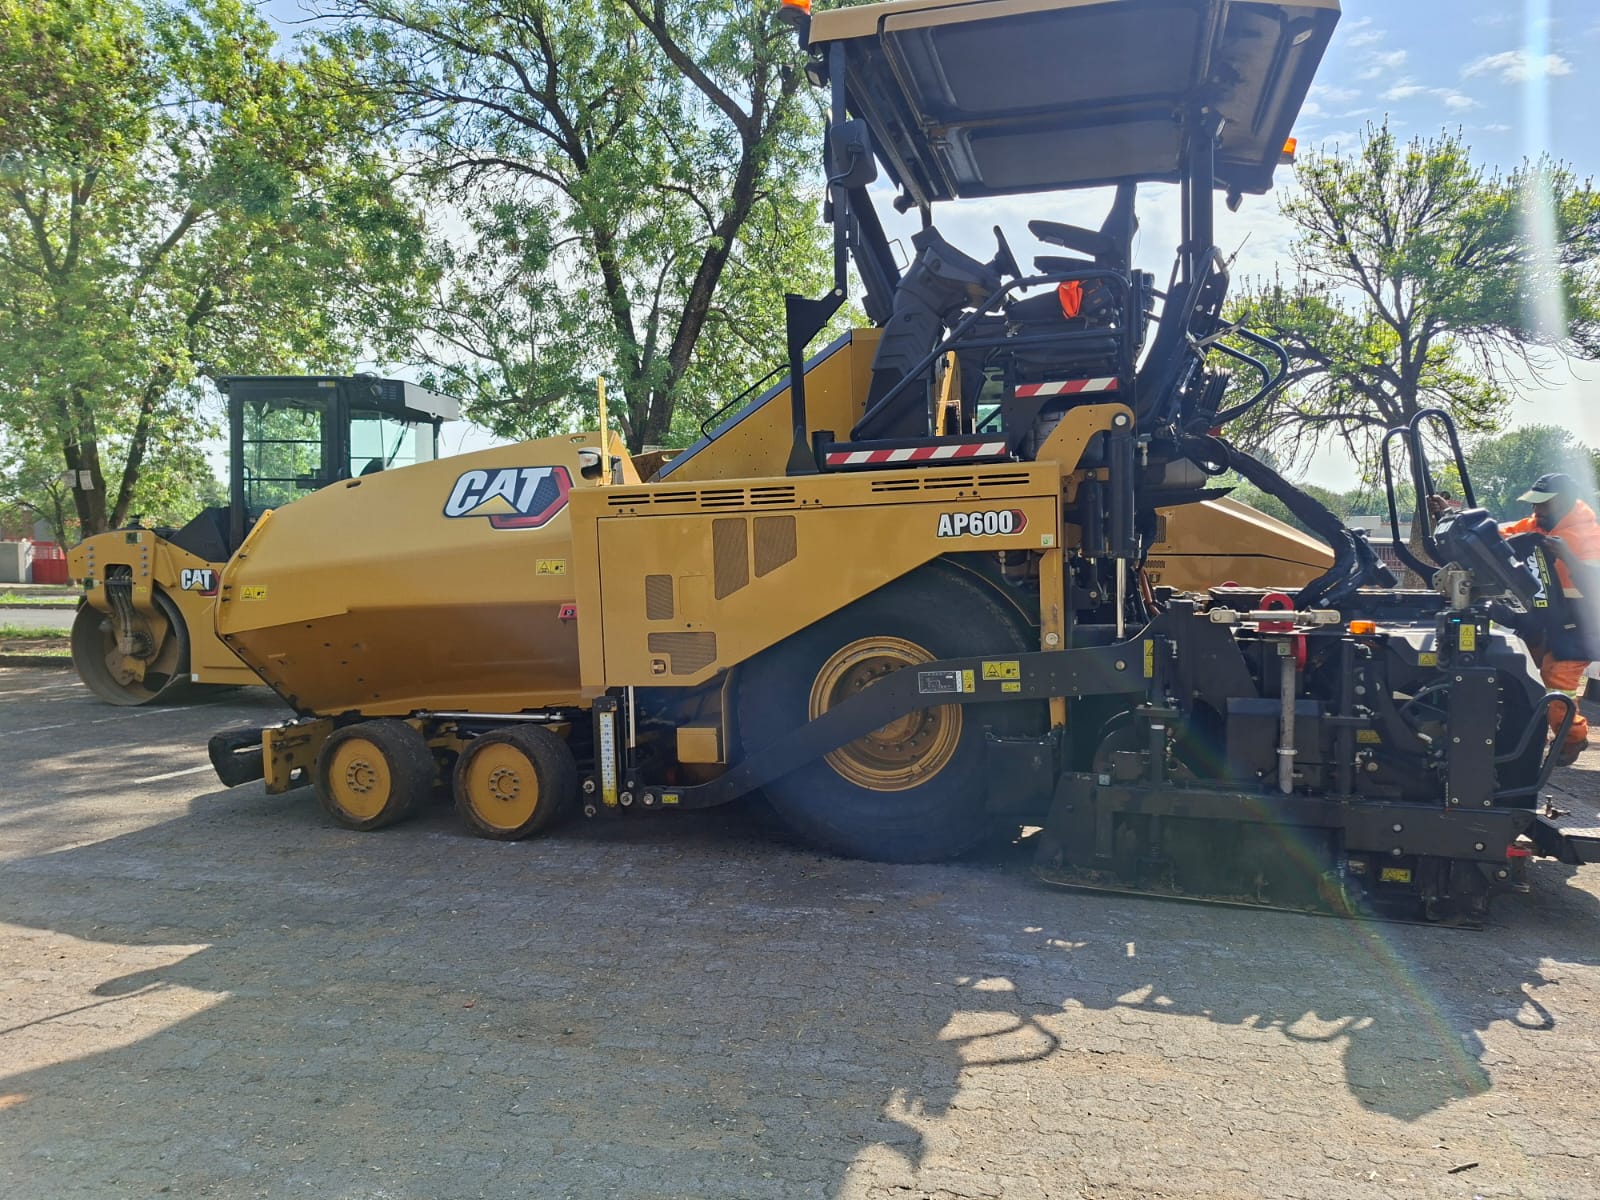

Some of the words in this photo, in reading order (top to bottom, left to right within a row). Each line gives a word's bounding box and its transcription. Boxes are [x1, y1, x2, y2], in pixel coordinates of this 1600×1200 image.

[444, 467, 553, 517] CAT
[937, 510, 1014, 536] AP600
[181, 569, 212, 590] CAT
